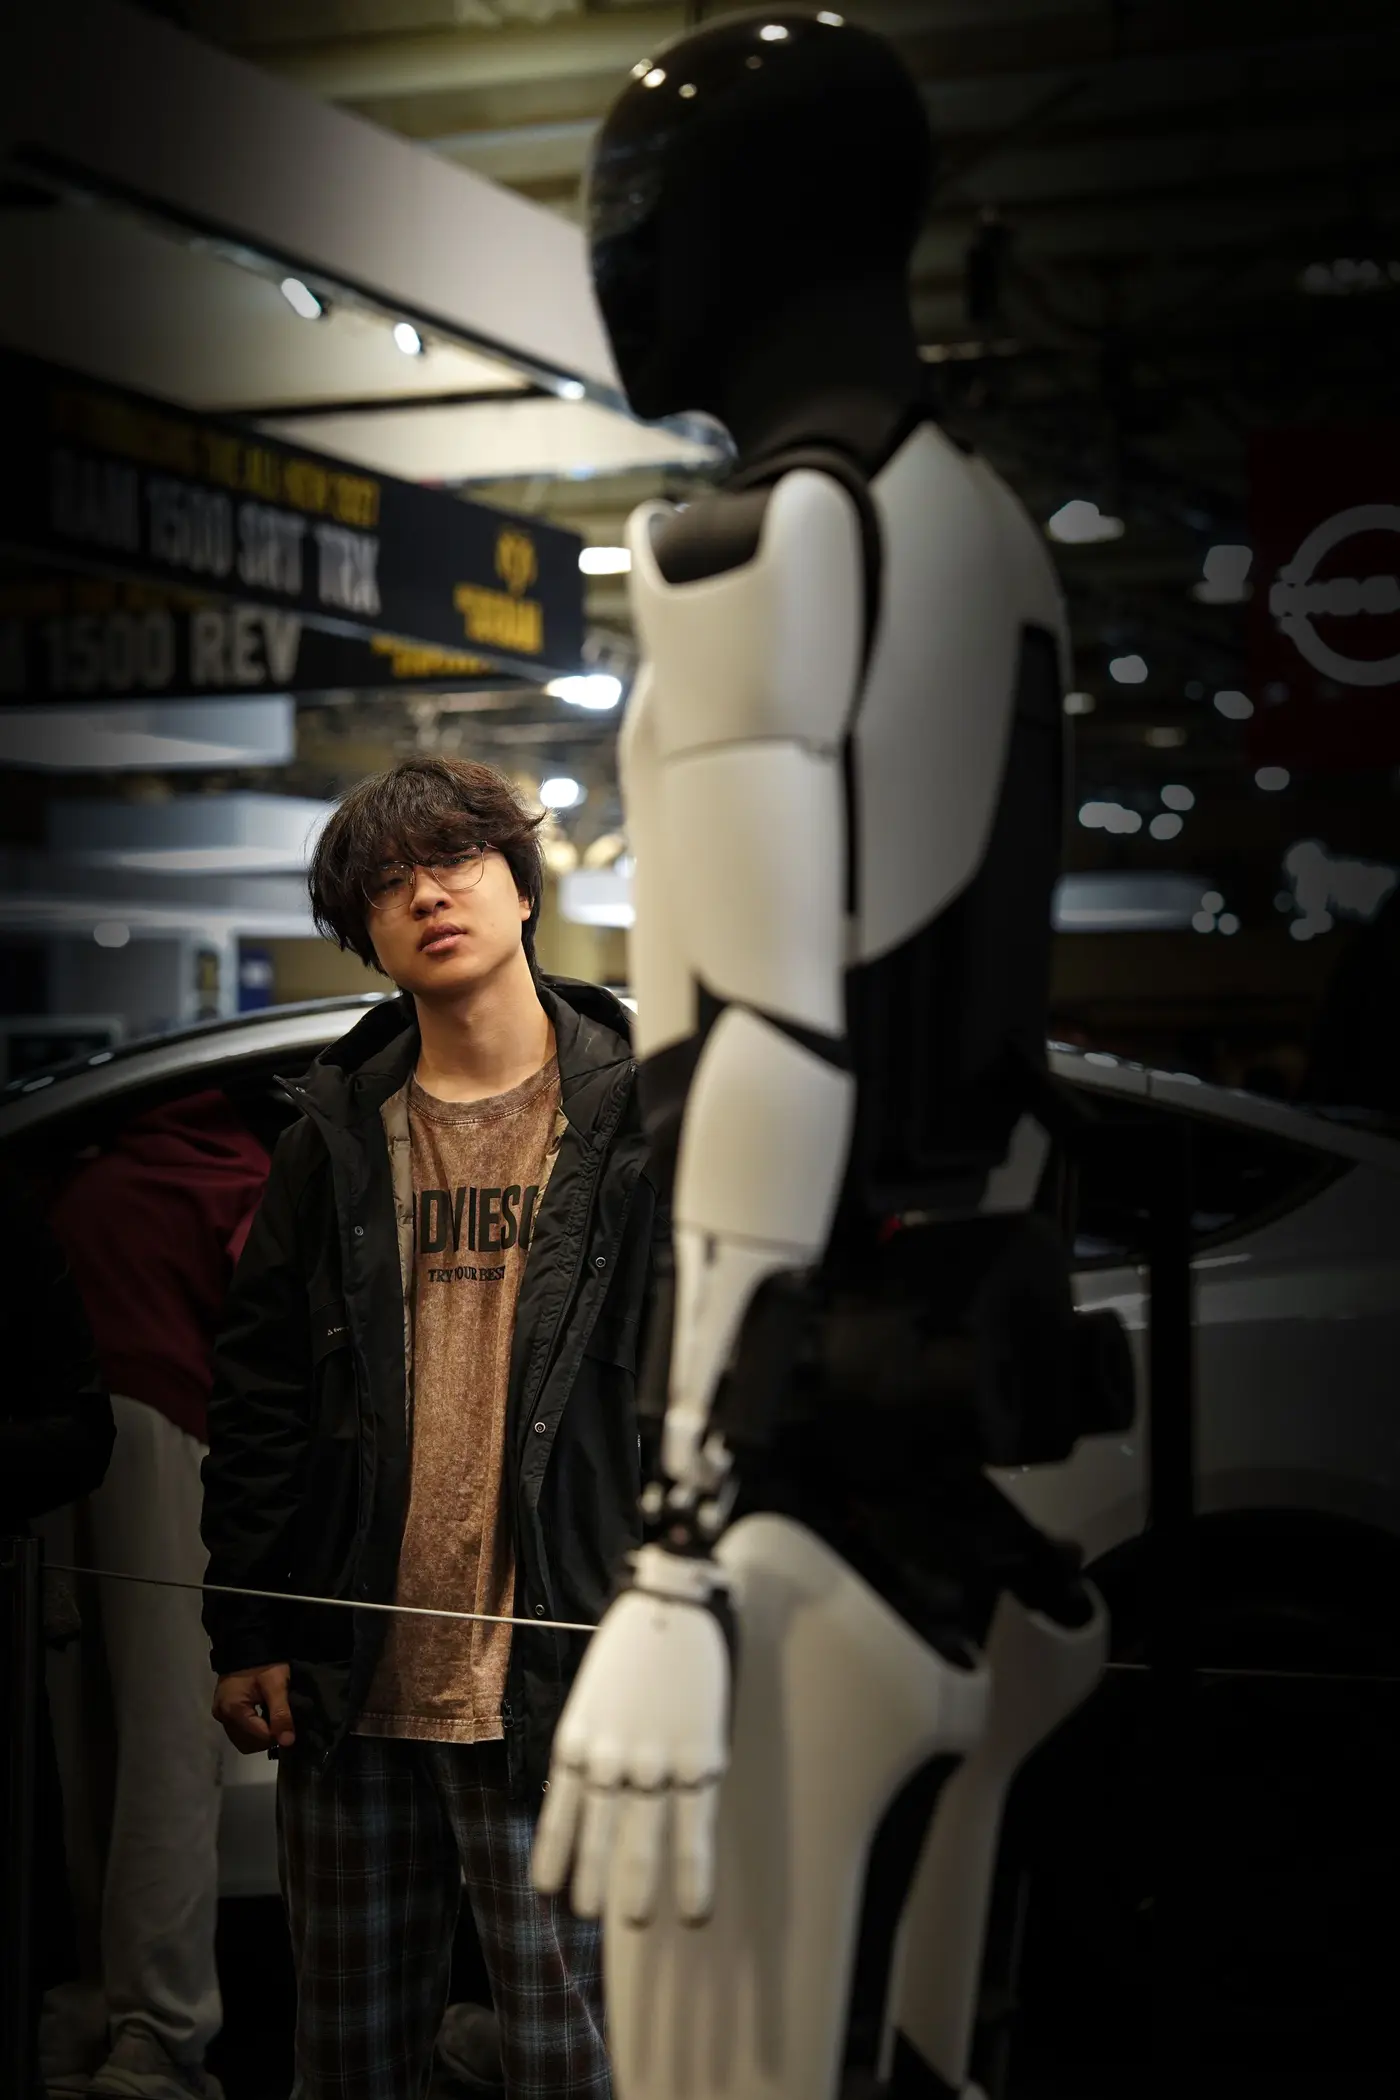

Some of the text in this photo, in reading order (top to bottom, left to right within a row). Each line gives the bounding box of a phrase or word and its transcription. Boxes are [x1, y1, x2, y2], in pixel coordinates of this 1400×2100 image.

[46, 609, 175, 691] 1500
[188, 600, 302, 687] REV
[412, 1184, 539, 1254] DVIES
[428, 1268, 453, 1283] TRY
